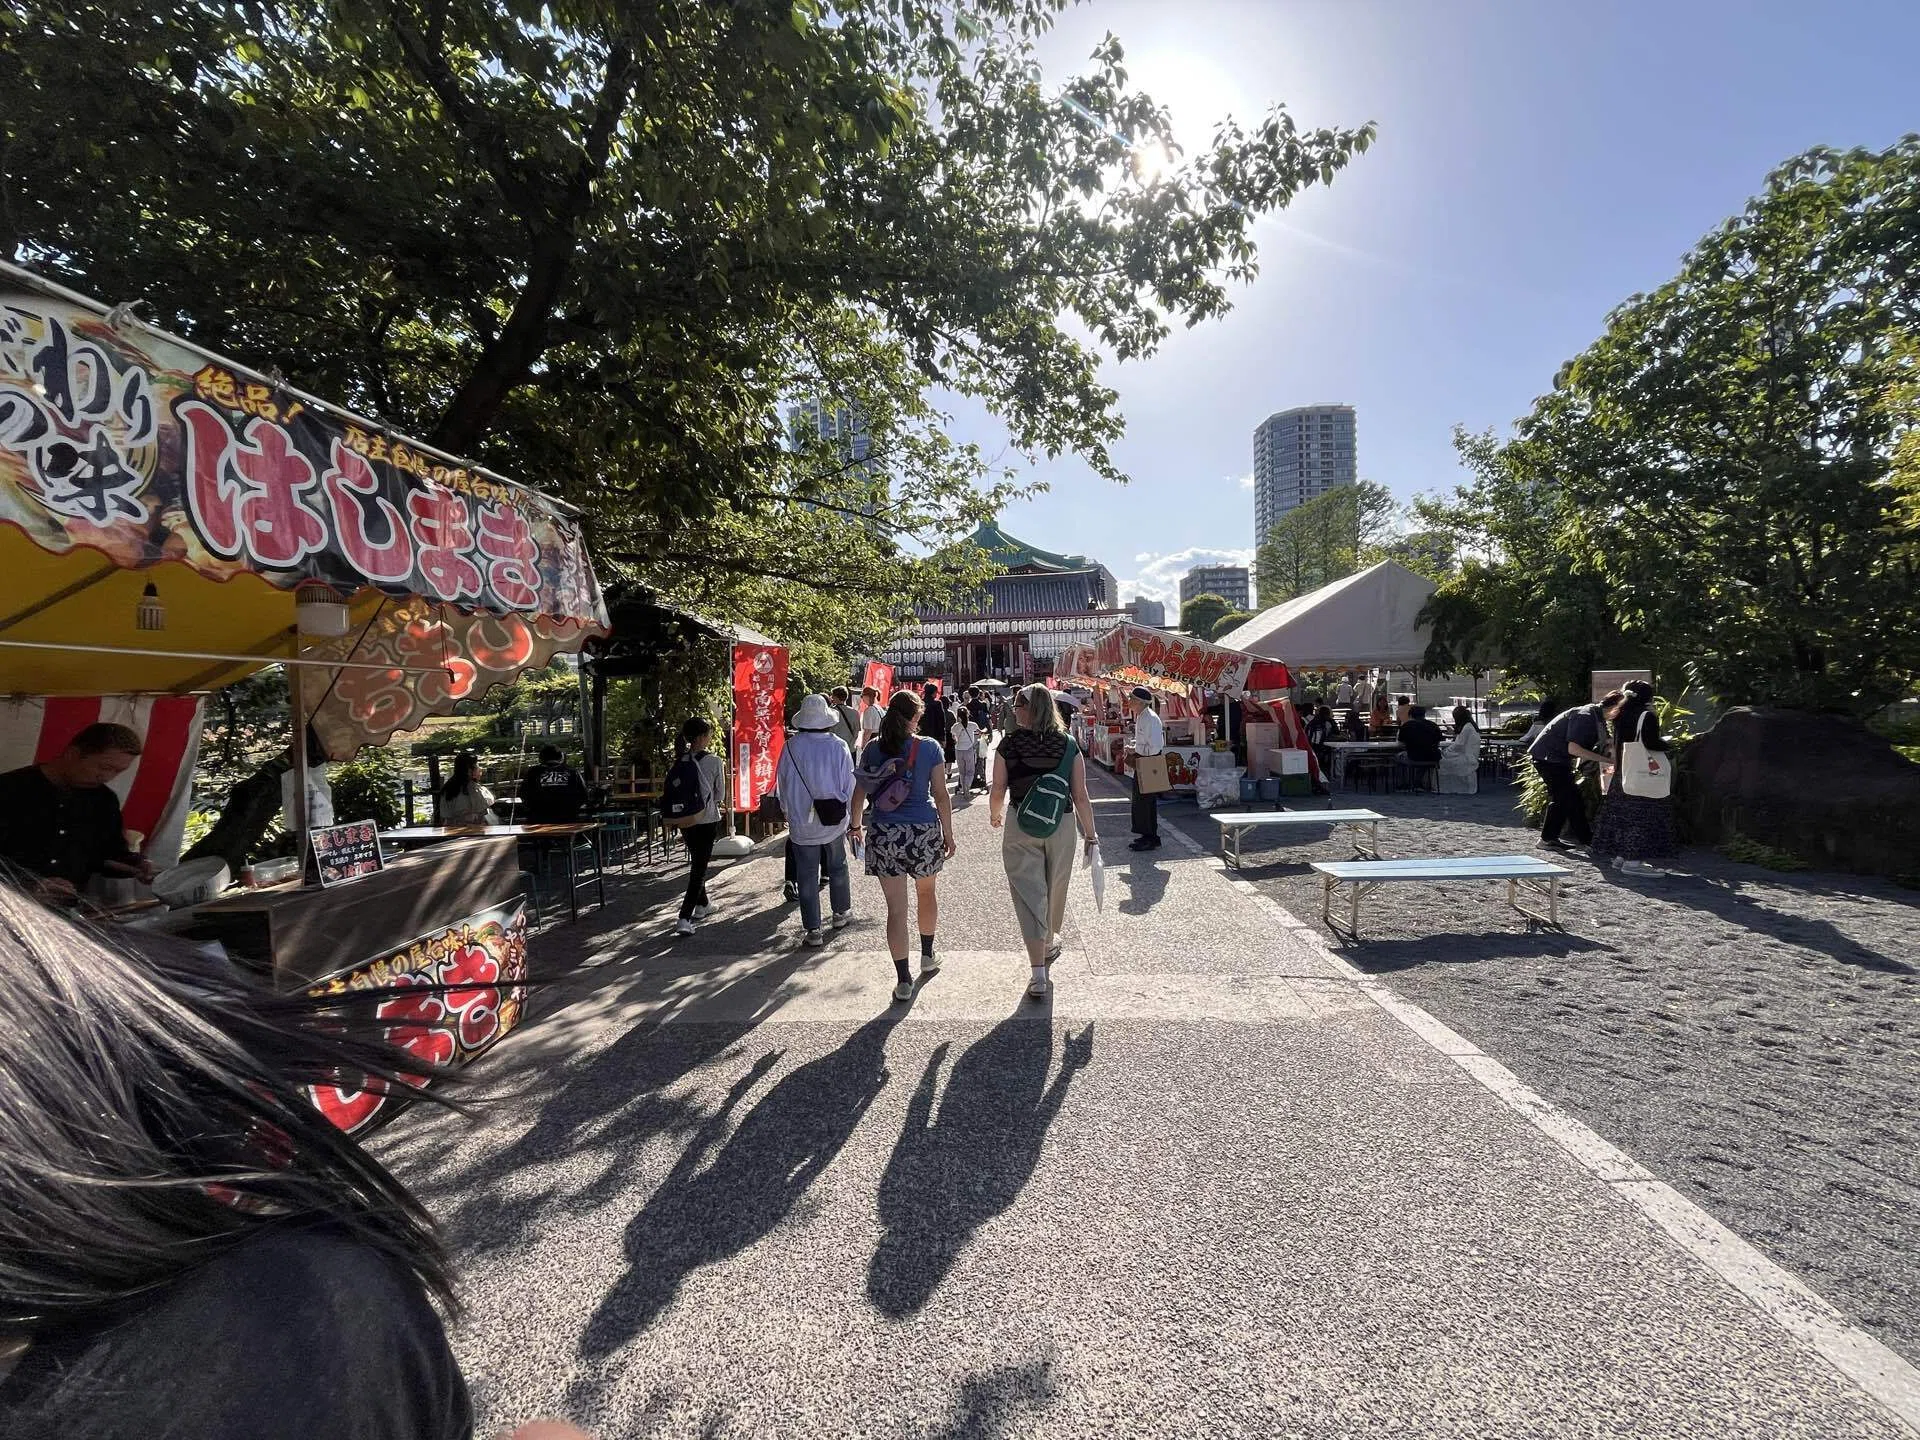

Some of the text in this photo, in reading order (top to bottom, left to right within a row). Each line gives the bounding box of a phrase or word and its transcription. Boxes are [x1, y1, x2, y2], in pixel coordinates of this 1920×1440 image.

[177, 401, 542, 608] はしまき
[1141, 636, 1227, 684] からあげ
